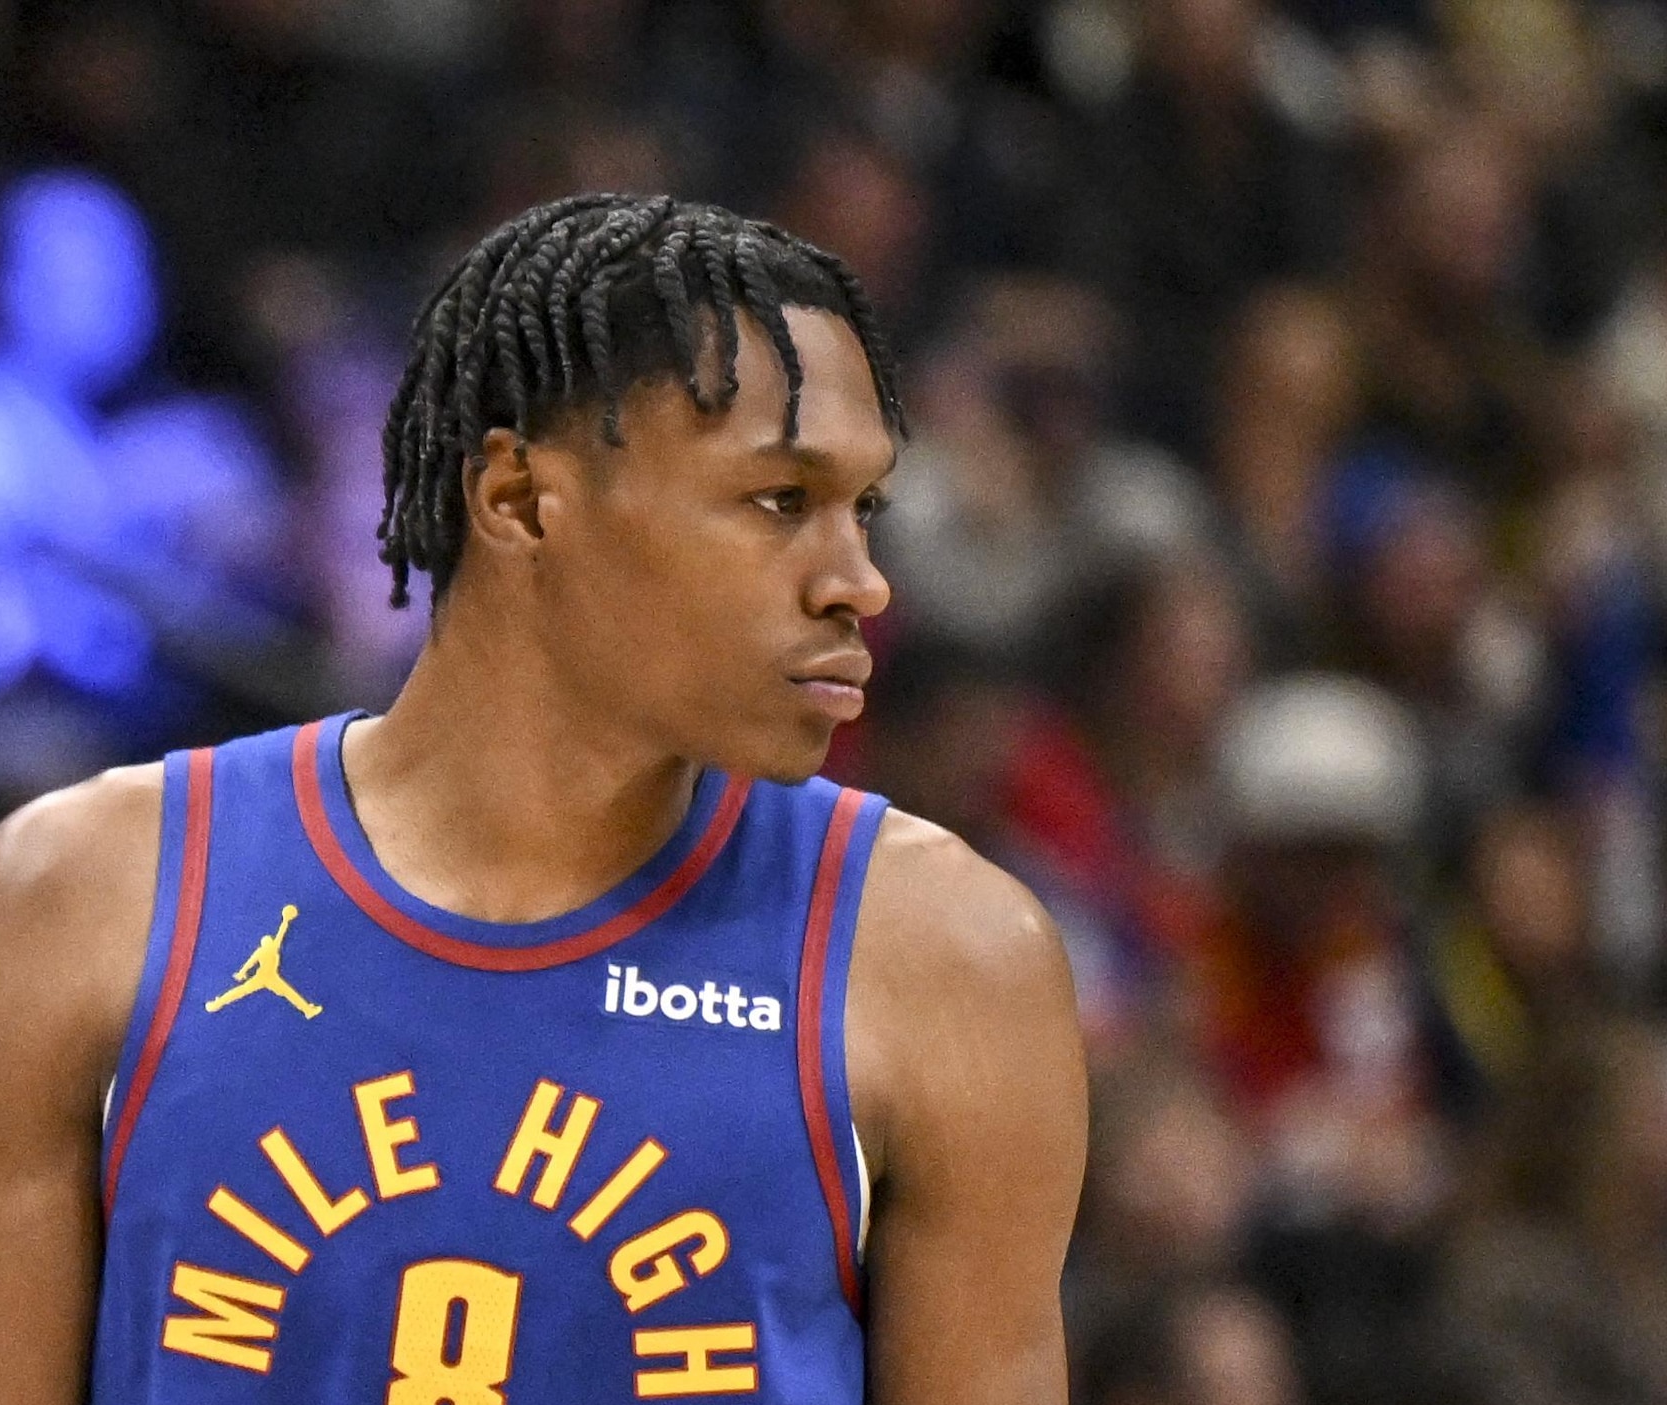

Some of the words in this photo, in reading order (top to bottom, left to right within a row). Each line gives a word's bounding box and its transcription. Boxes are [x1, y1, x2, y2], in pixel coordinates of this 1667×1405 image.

[604, 963, 782, 1033] ibotta
[160, 1070, 441, 1375] MILE
[492, 1078, 760, 1400] HIGH
